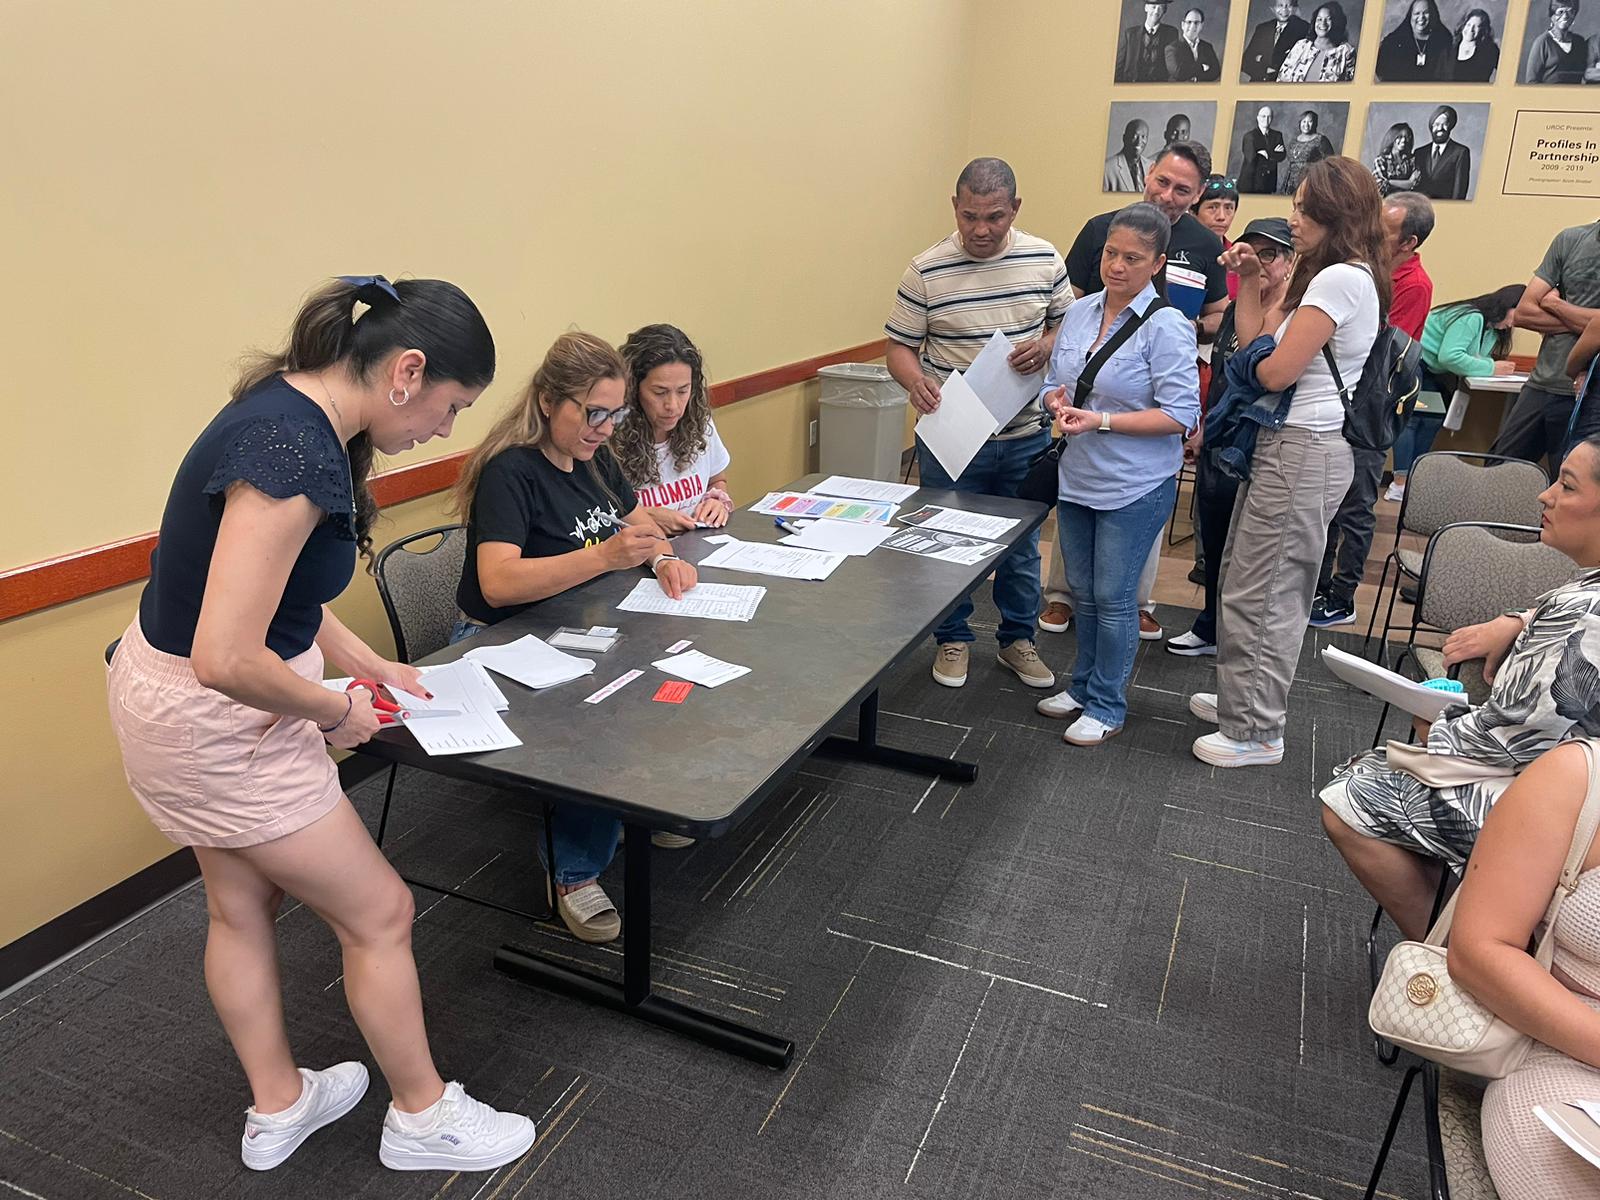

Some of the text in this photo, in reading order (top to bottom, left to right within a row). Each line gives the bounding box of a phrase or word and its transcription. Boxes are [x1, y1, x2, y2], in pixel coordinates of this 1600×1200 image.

[1537, 139, 1597, 150] Profiles In
[1529, 151, 1599, 164] Partnership
